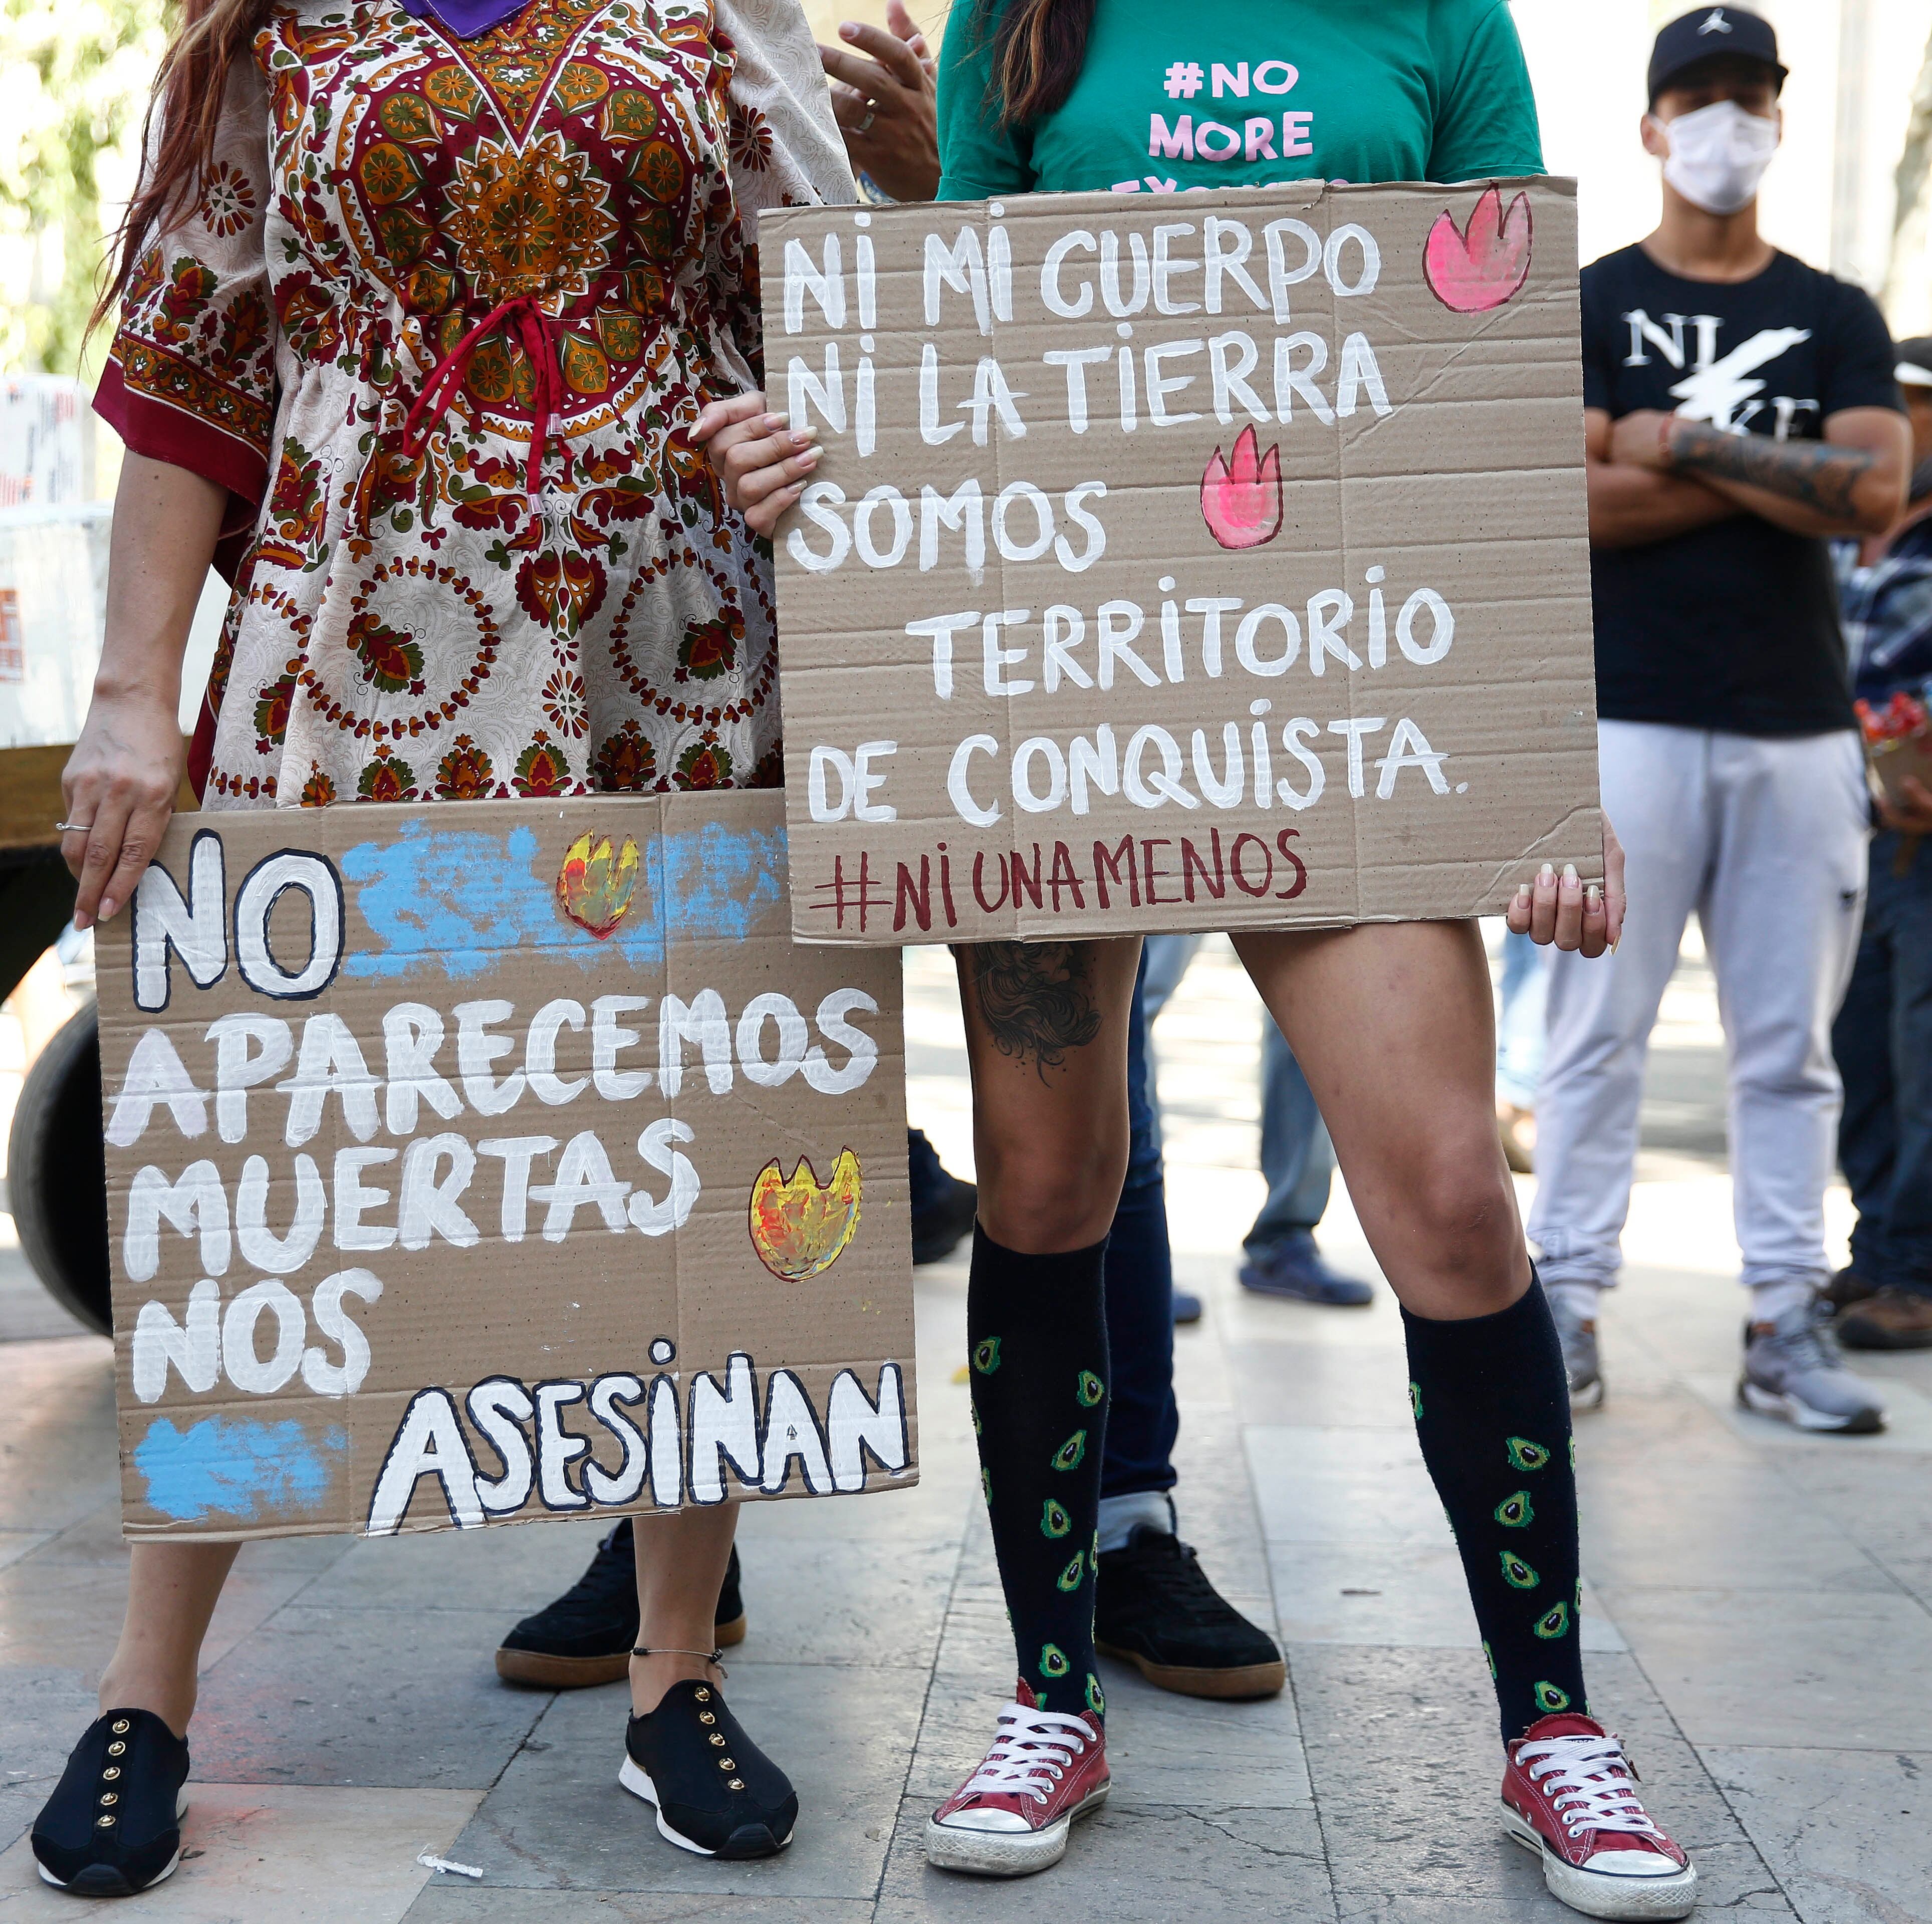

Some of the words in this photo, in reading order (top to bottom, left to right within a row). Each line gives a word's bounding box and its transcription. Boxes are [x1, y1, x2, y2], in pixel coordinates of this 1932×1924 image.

[1149, 111, 1313, 161] MORE
[1164, 60, 1299, 98] #NO
[784, 211, 877, 335] NI
[923, 203, 1013, 336] MI
[1041, 216, 1382, 325] CUERPO
[788, 334, 877, 457] NI
[919, 343, 1031, 447] LA
[1043, 323, 1393, 434] TIERRA
[787, 479, 1108, 574] SOMOS
[905, 565, 1455, 700] TERRITORIO
[808, 741, 897, 823] DE
[947, 698, 1469, 828] CONQUISTA.
[131, 828, 345, 1013] NO
[105, 988, 879, 1148] APARECEMOS
[124, 1118, 701, 1282] MUERTAS
[132, 1268, 384, 1403] NOS
[365, 1337, 913, 1536] ASESINAN
